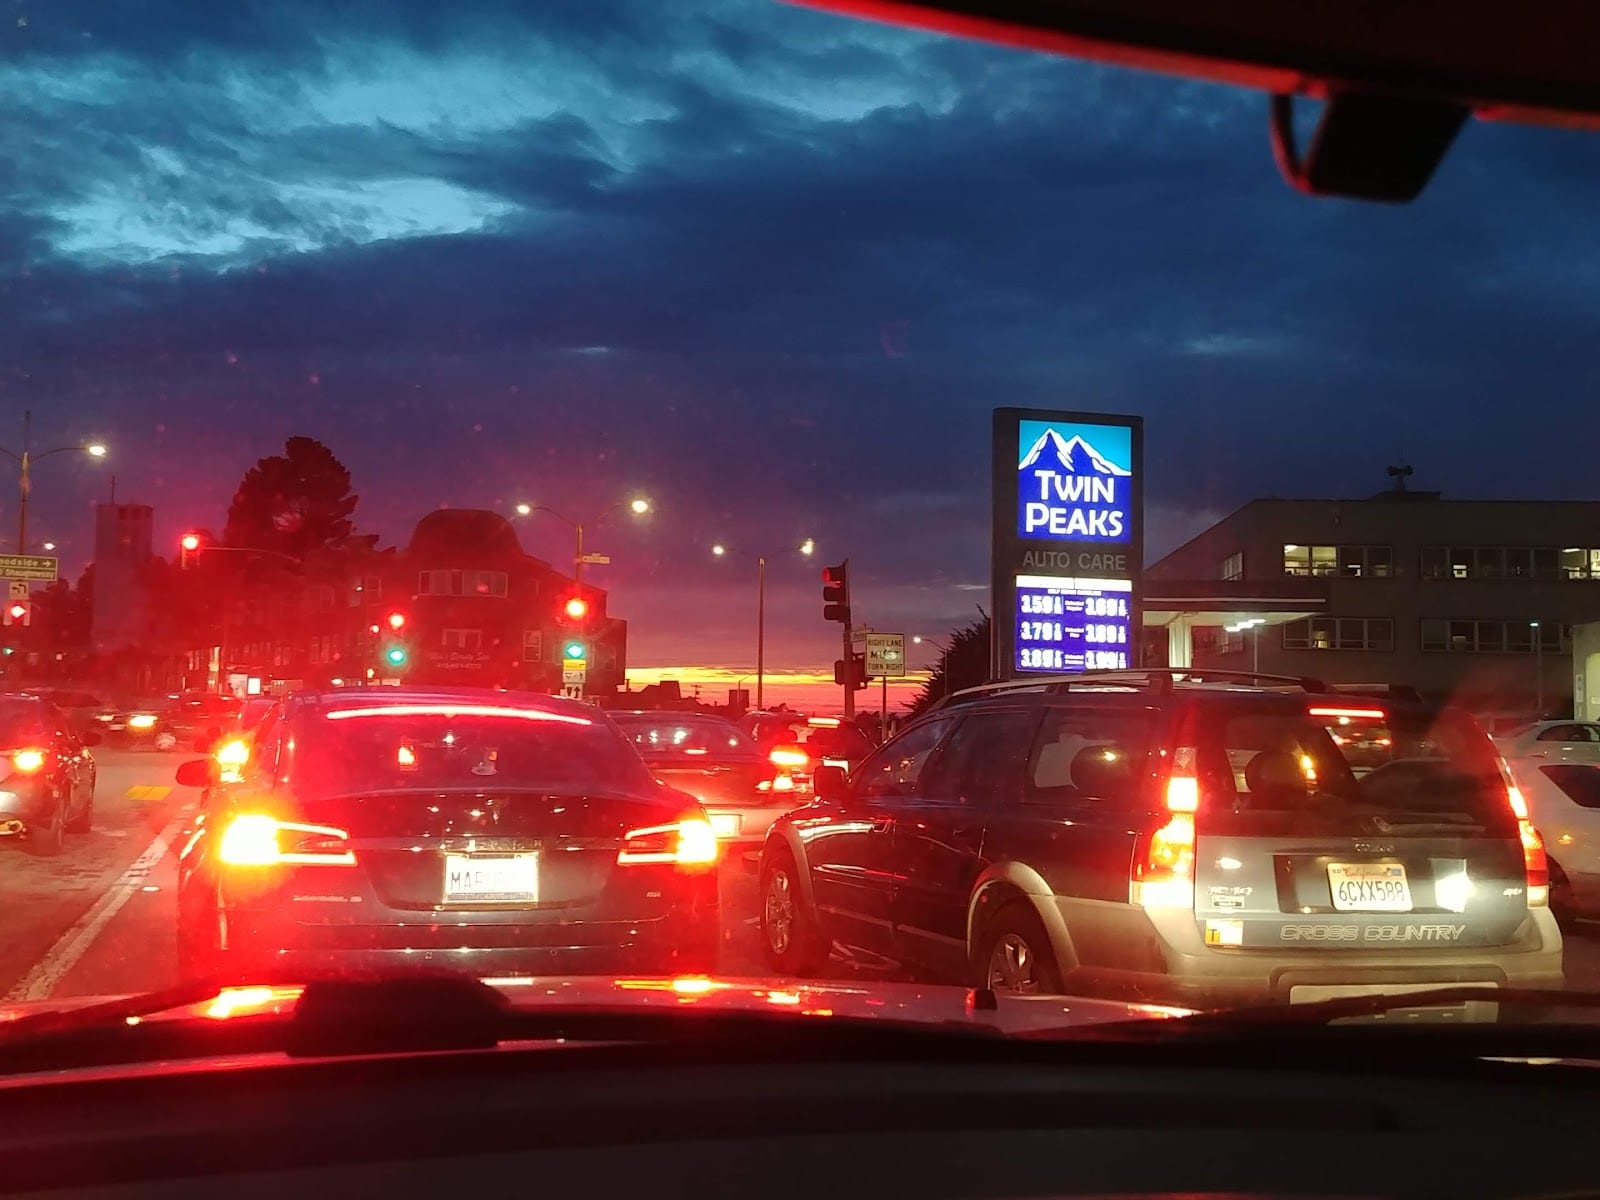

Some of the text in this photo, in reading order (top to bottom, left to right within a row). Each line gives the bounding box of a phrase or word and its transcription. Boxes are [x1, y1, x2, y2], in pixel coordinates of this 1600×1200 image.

[1034, 469, 1115, 503] TWIN
[1025, 502, 1124, 537] PEAKS
[1022, 551, 1127, 571] AUTO CARE
[886, 640, 902, 648] LANE
[1338, 881, 1405, 902] 6CXX588
[1280, 924, 1467, 941] CROSS COUNTRY
